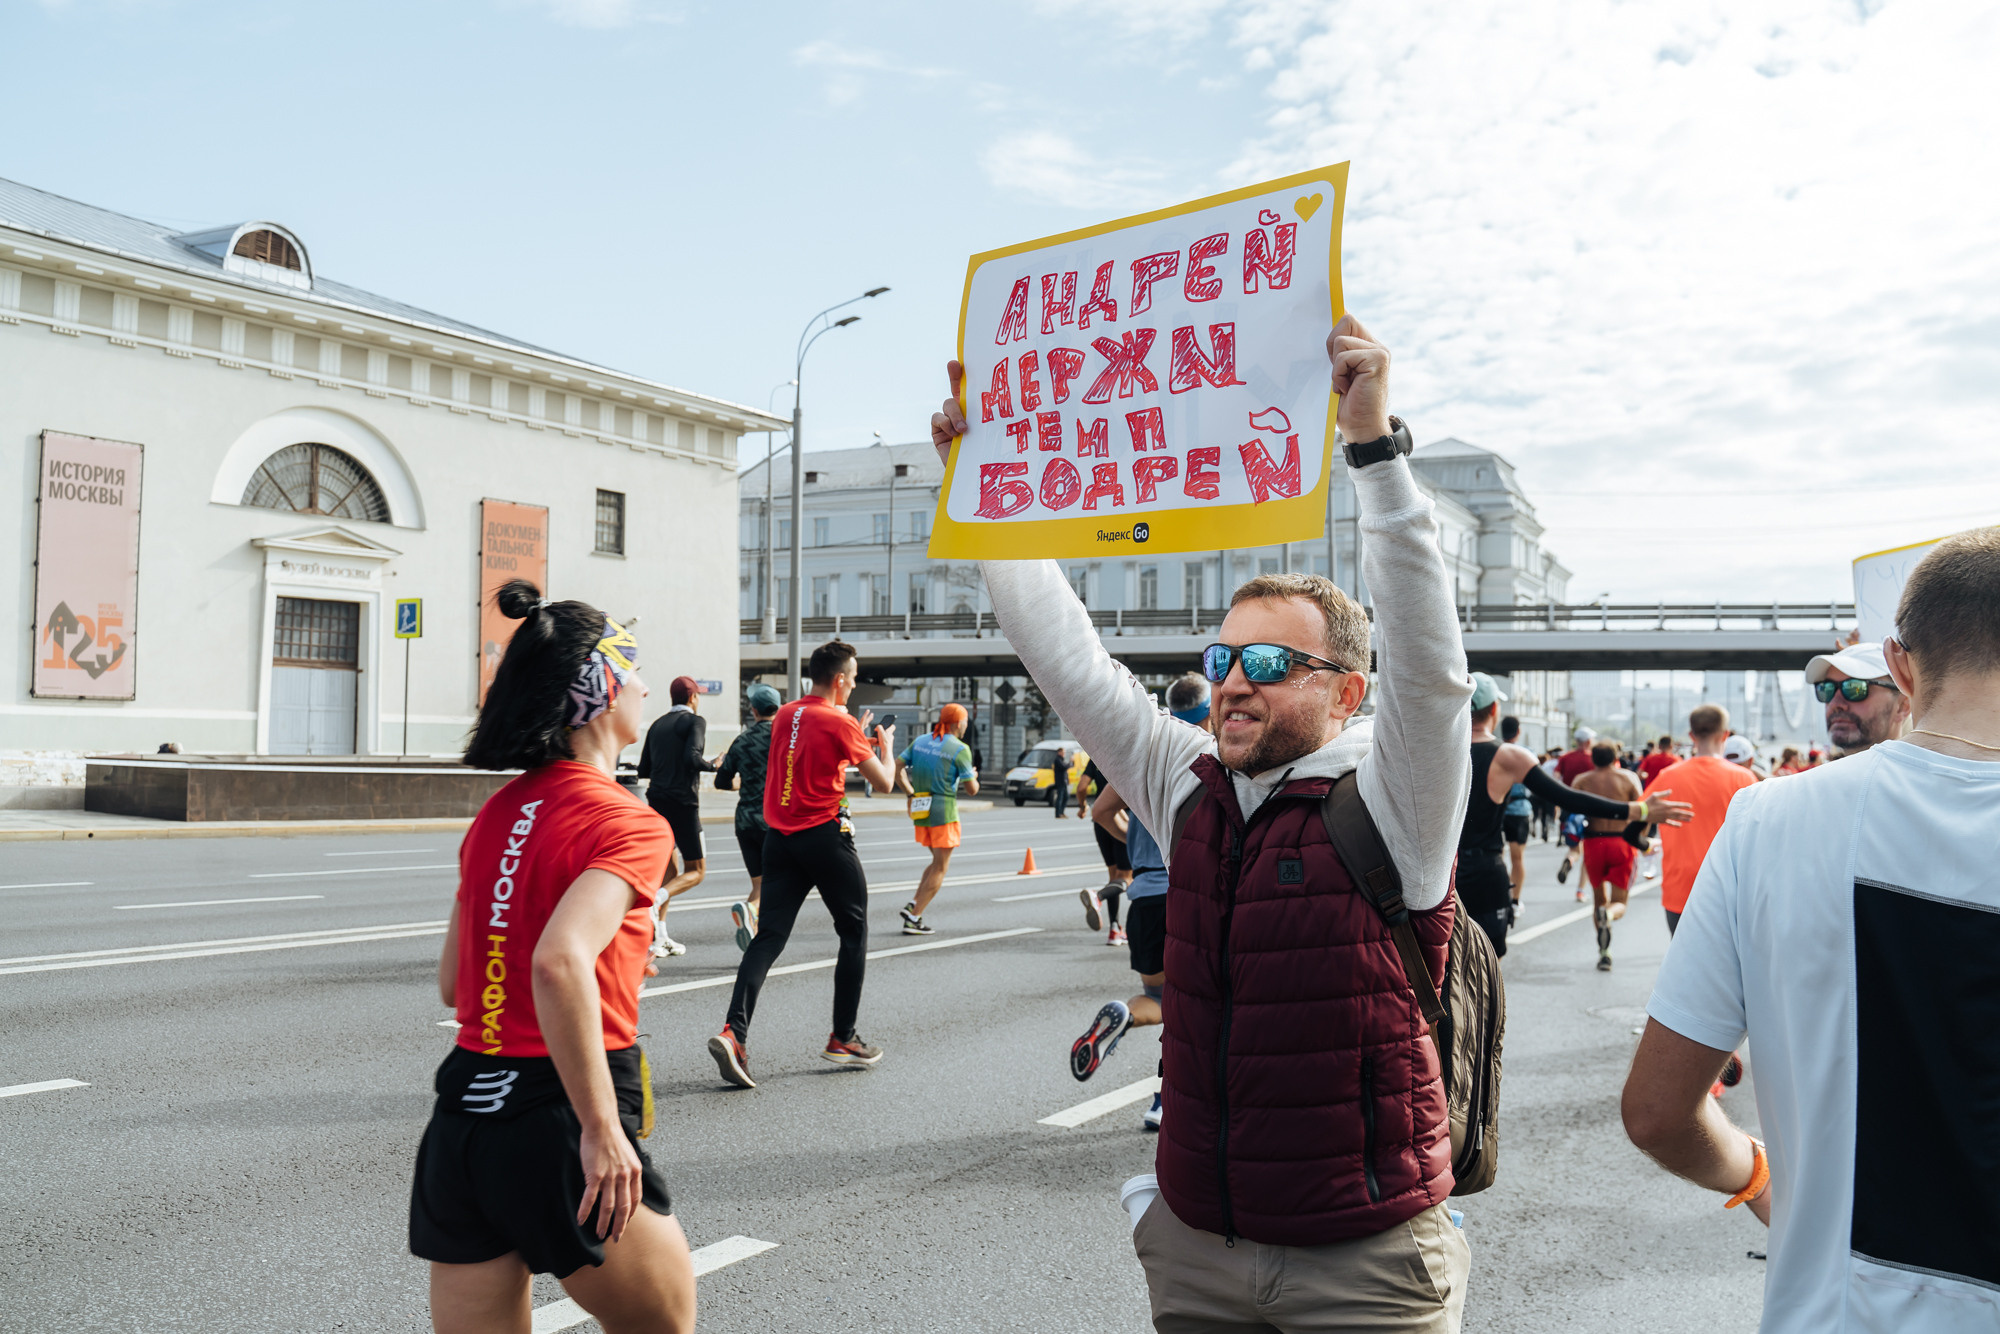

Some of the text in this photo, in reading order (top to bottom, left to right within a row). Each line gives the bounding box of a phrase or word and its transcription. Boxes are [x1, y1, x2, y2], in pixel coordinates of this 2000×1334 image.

[995, 209, 1298, 346] АНДРЕЙ
[981, 321, 1247, 424] ДЕРЖИ
[1006, 406, 1167, 458] ТЕМП
[49, 459, 126, 487] ИСТОРИЯ
[973, 406, 1302, 520] БОДРЕЙ
[48, 480, 124, 507] МОСКВЫ
[486, 537, 536, 558] ТАЛЬНОЕ
[1096, 526, 1149, 543] Яндекс Go
[486, 554, 518, 572] КИНО
[781, 706, 808, 806] МАРАФОН МОСКВА
[481, 799, 545, 1056] АРАФОН МОСКВА
